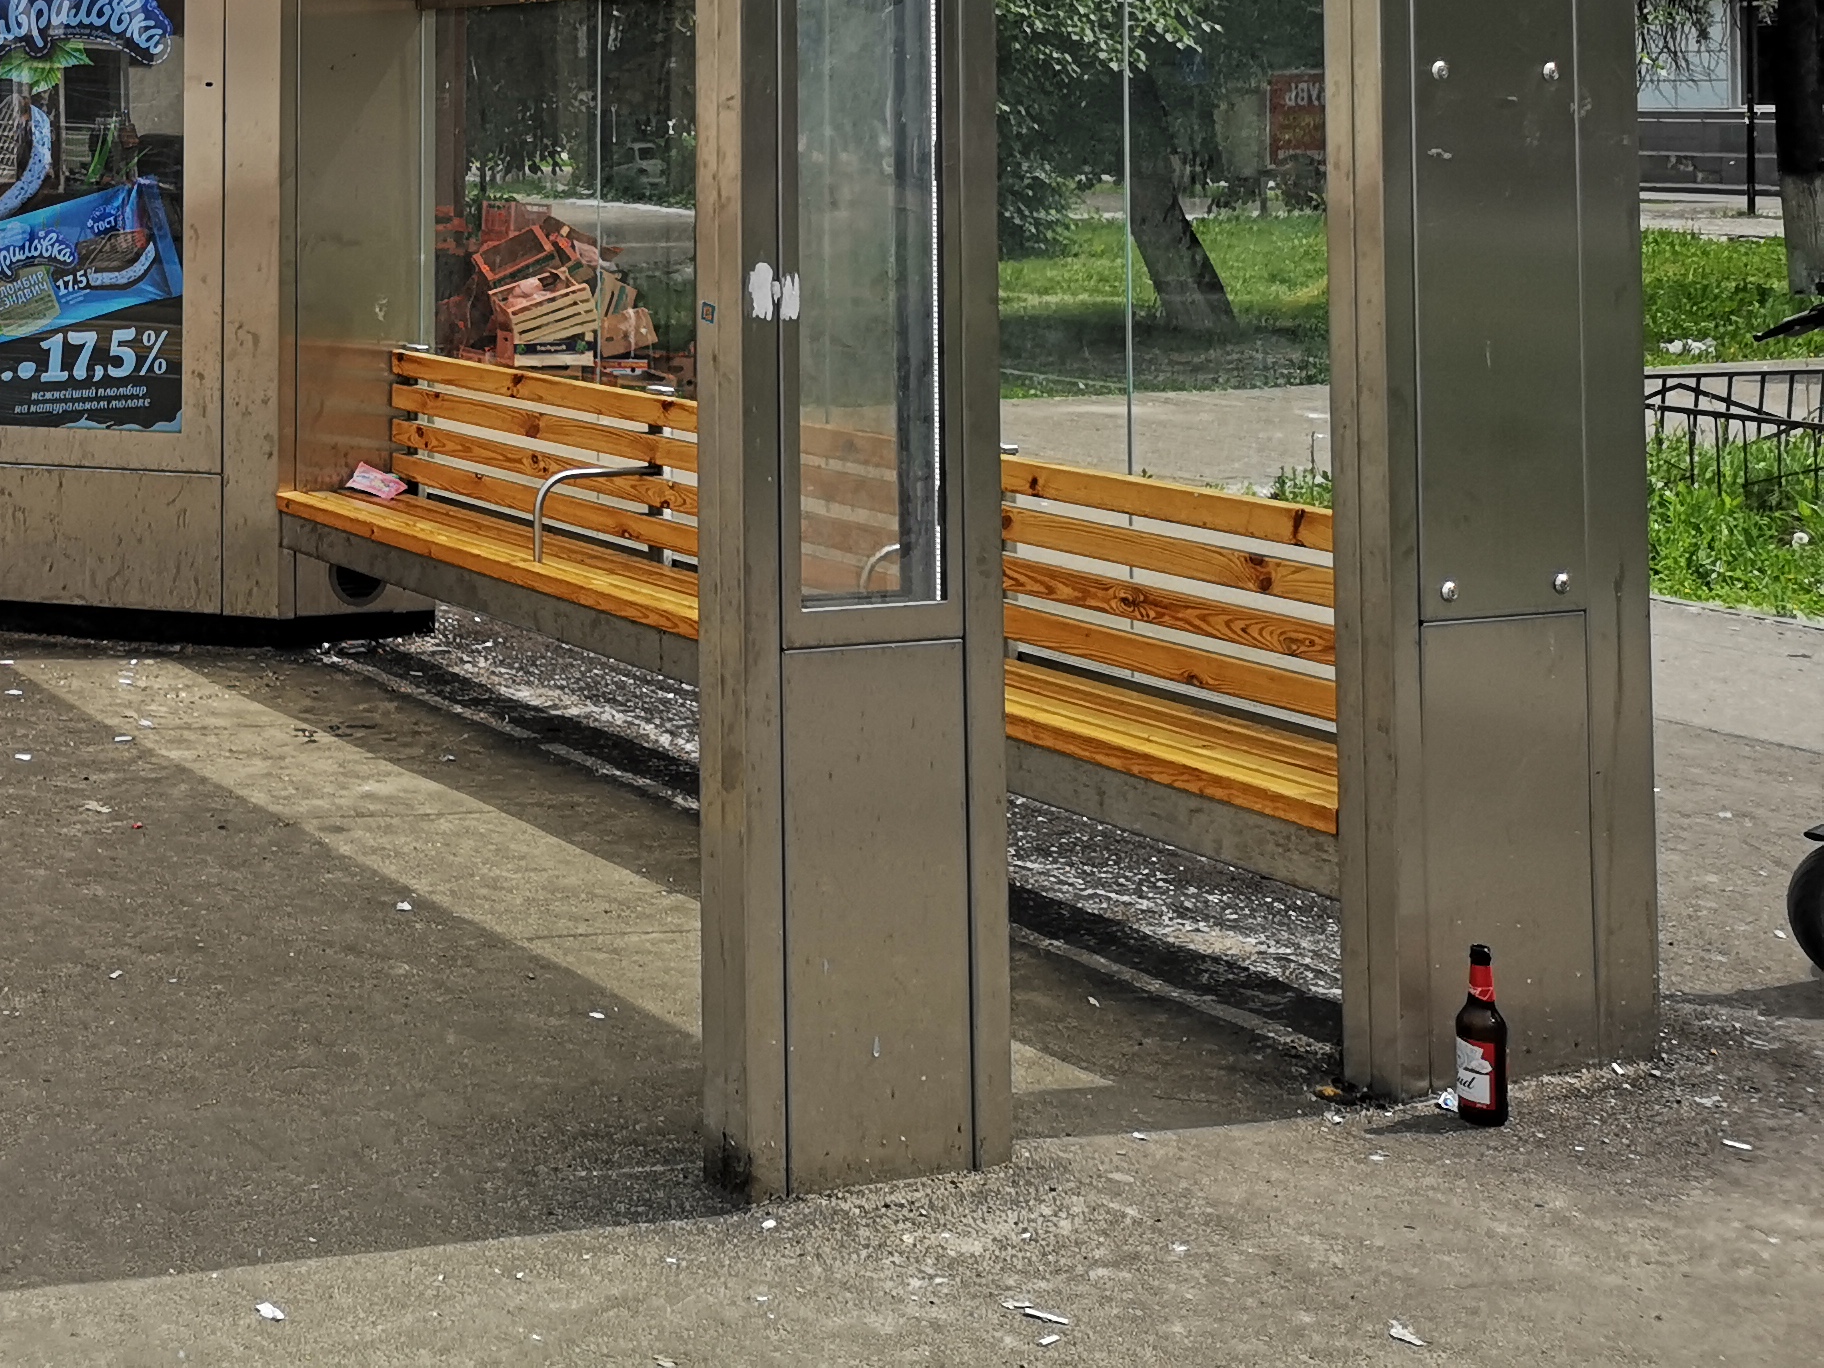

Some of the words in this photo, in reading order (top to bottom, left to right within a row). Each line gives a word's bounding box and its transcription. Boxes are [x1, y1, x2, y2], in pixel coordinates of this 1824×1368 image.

[93, 215, 116, 233] ГОСТ
[31, 386, 96, 401] нежнейший
[97, 383, 147, 398] пломбир
[14, 403, 28, 414] на
[29, 401, 108, 415] натуральном
[109, 397, 151, 409] молоке
[1457, 1076, 1476, 1089] ud
